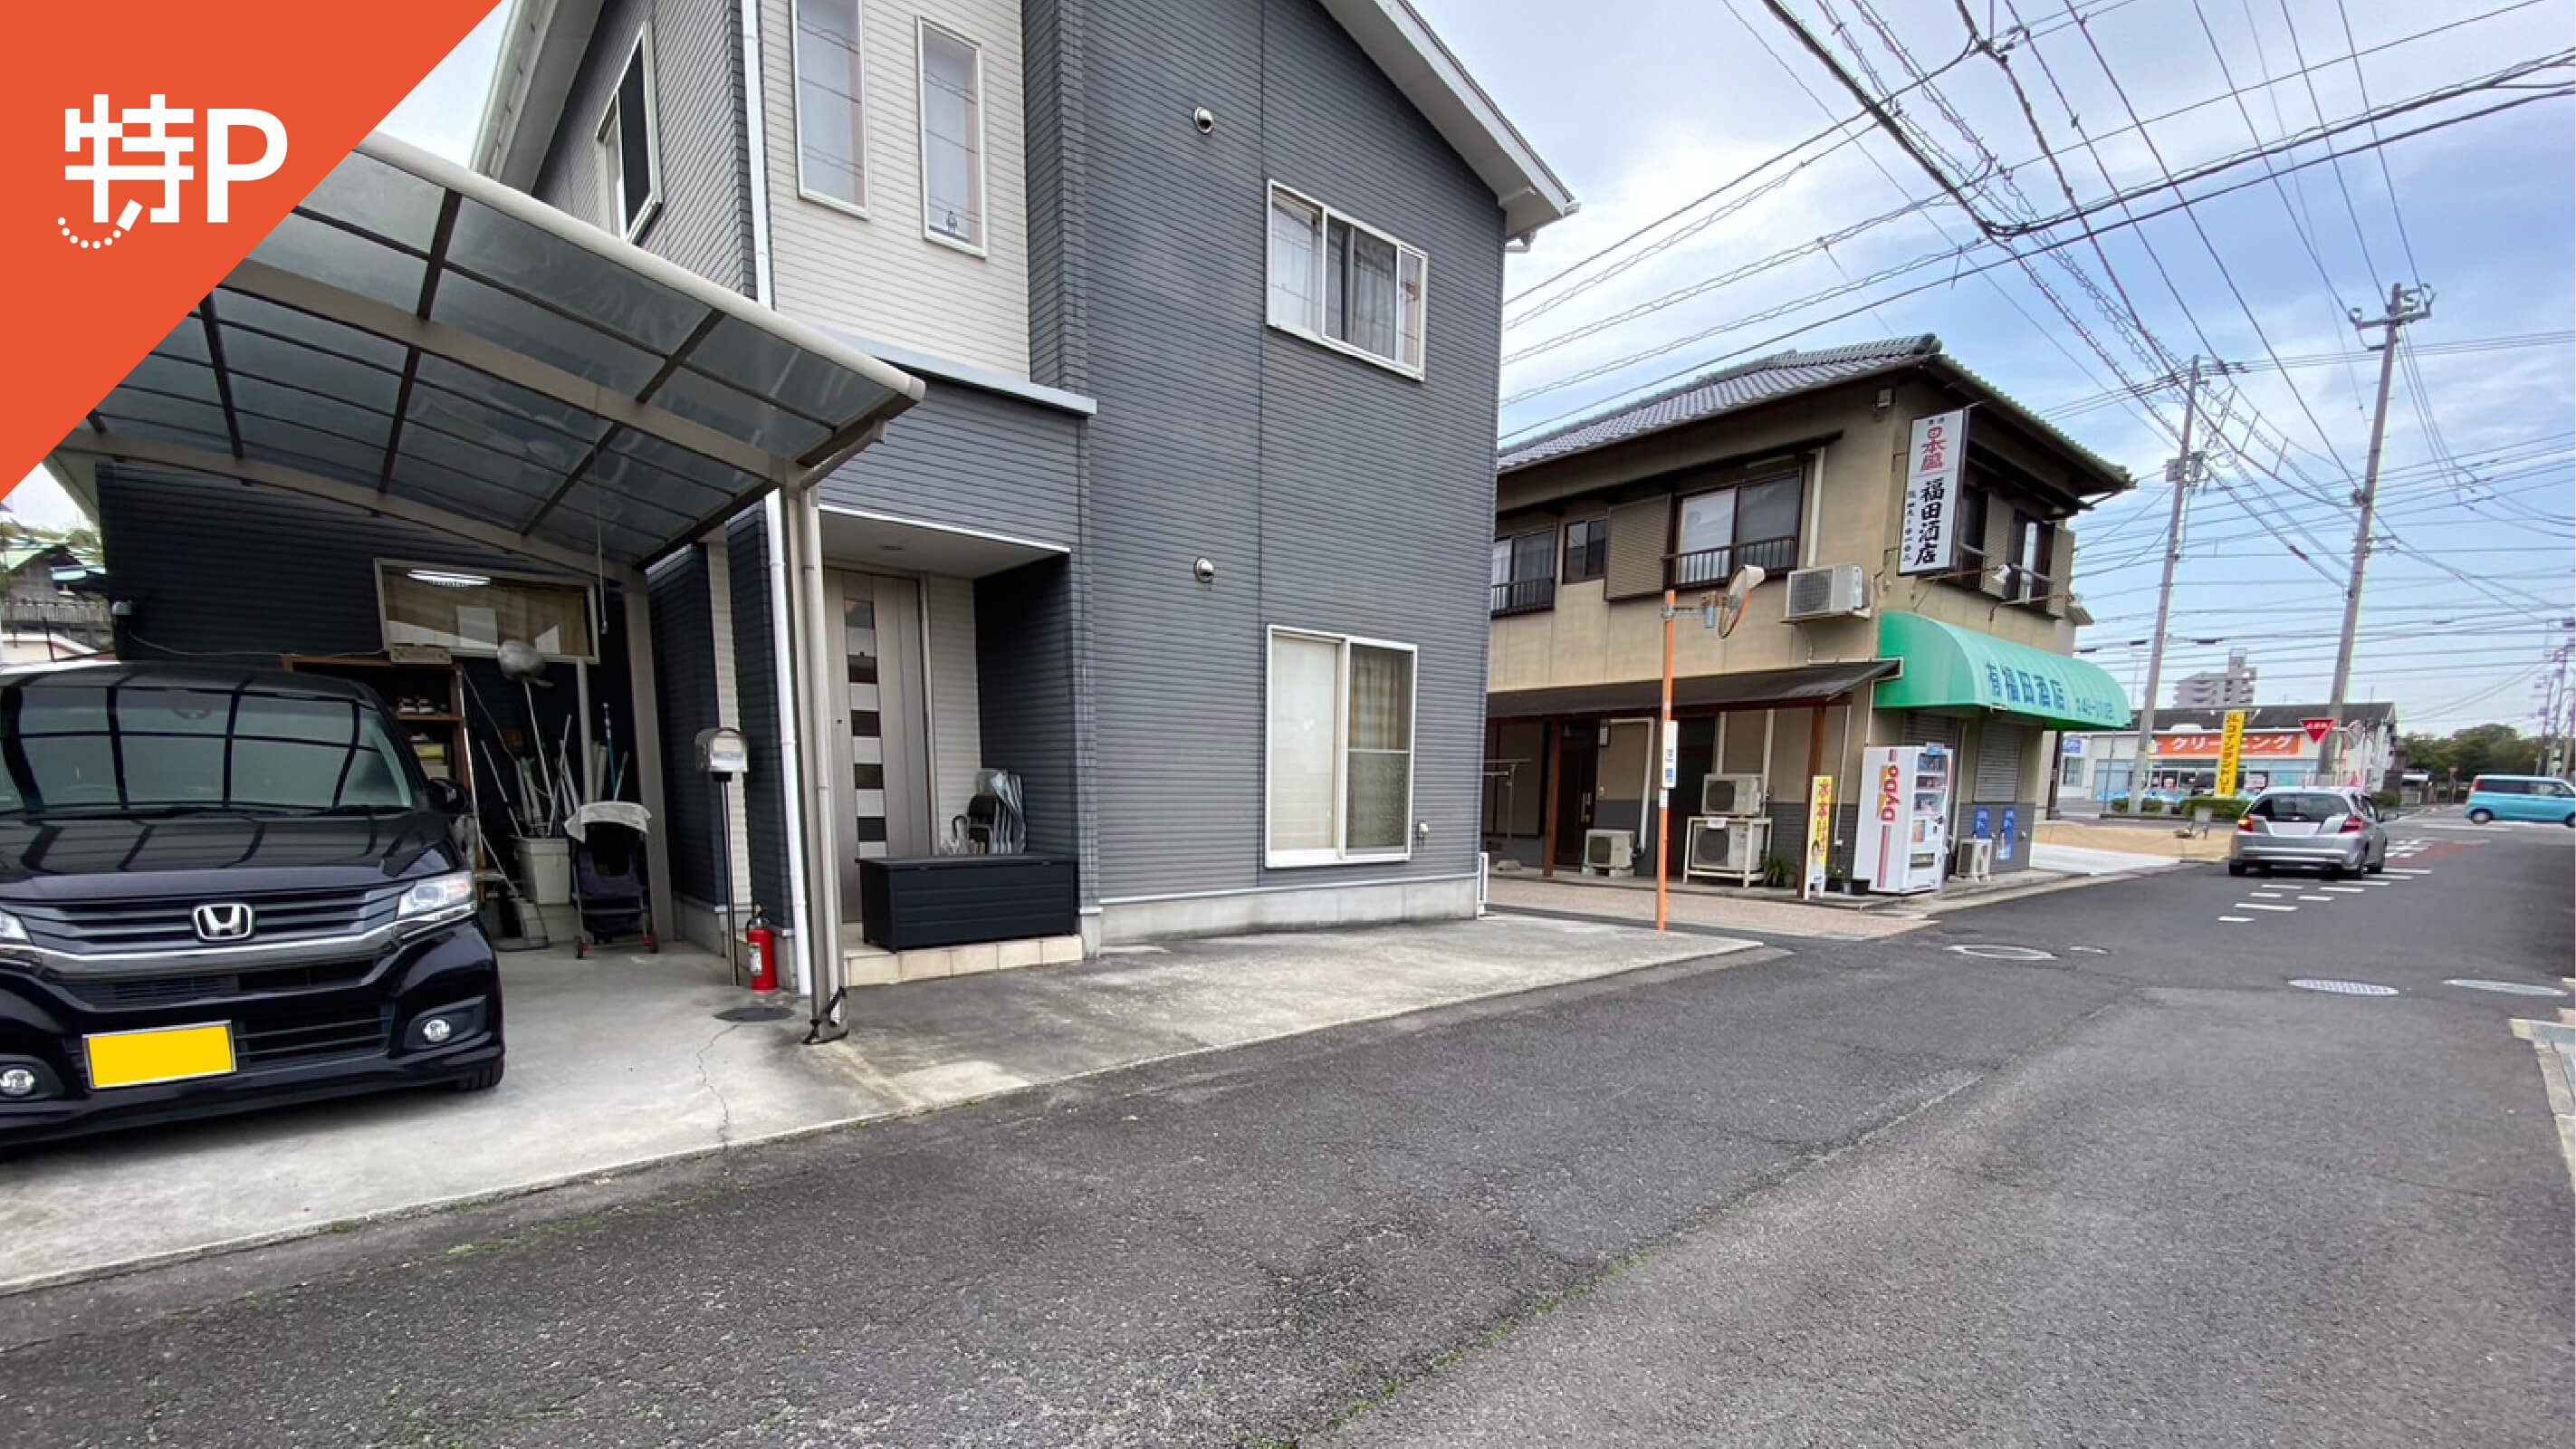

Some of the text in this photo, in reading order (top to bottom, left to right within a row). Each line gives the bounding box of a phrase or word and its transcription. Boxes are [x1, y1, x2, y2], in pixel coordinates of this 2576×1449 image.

[1914, 476, 1945, 566] 福田酒店
[1880, 765, 1900, 821] DyDo
